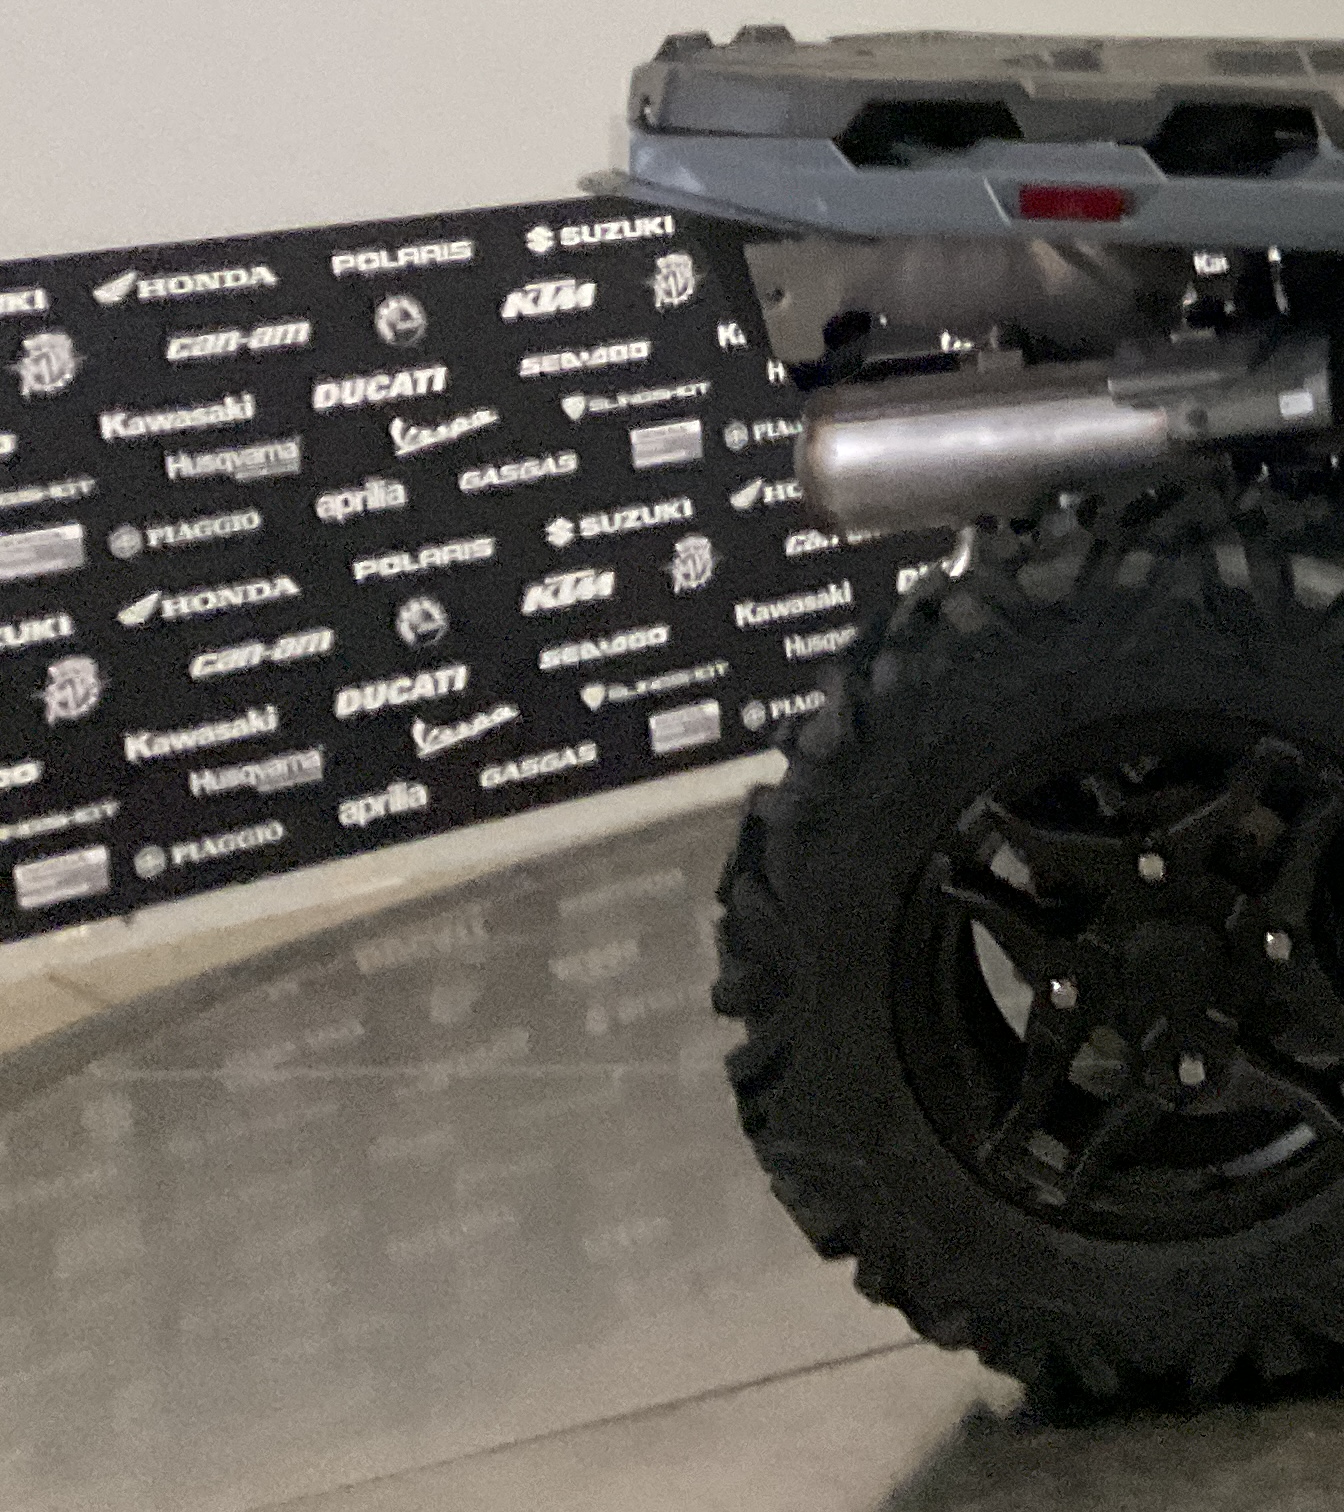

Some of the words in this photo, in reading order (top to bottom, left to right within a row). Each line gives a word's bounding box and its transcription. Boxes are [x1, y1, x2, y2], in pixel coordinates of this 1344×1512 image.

[559, 215, 675, 247] SUZUKI
[331, 238, 474, 276] POLARIS
[137, 265, 278, 300] HONDA
[501, 277, 596, 320] KTM
[166, 321, 311, 361] can-am
[313, 364, 447, 411] DUCATI
[100, 392, 255, 440] Kawasaki
[459, 452, 578, 493] GASGAS
[316, 478, 408, 522] aprilia
[579, 497, 693, 538] SUZUKI
[145, 510, 261, 547] PIAGGIO
[353, 537, 495, 581] POLARIS
[160, 576, 300, 619] HONDA
[522, 568, 615, 615] KTM
[735, 580, 852, 627] Kawasaki
[190, 628, 334, 679] can-am
[335, 664, 468, 718] DUCATI
[125, 705, 278, 762] Kawasaki
[480, 743, 597, 788] GASGAS
[339, 782, 428, 826] aprilia
[171, 821, 284, 864] PIAGGIO
